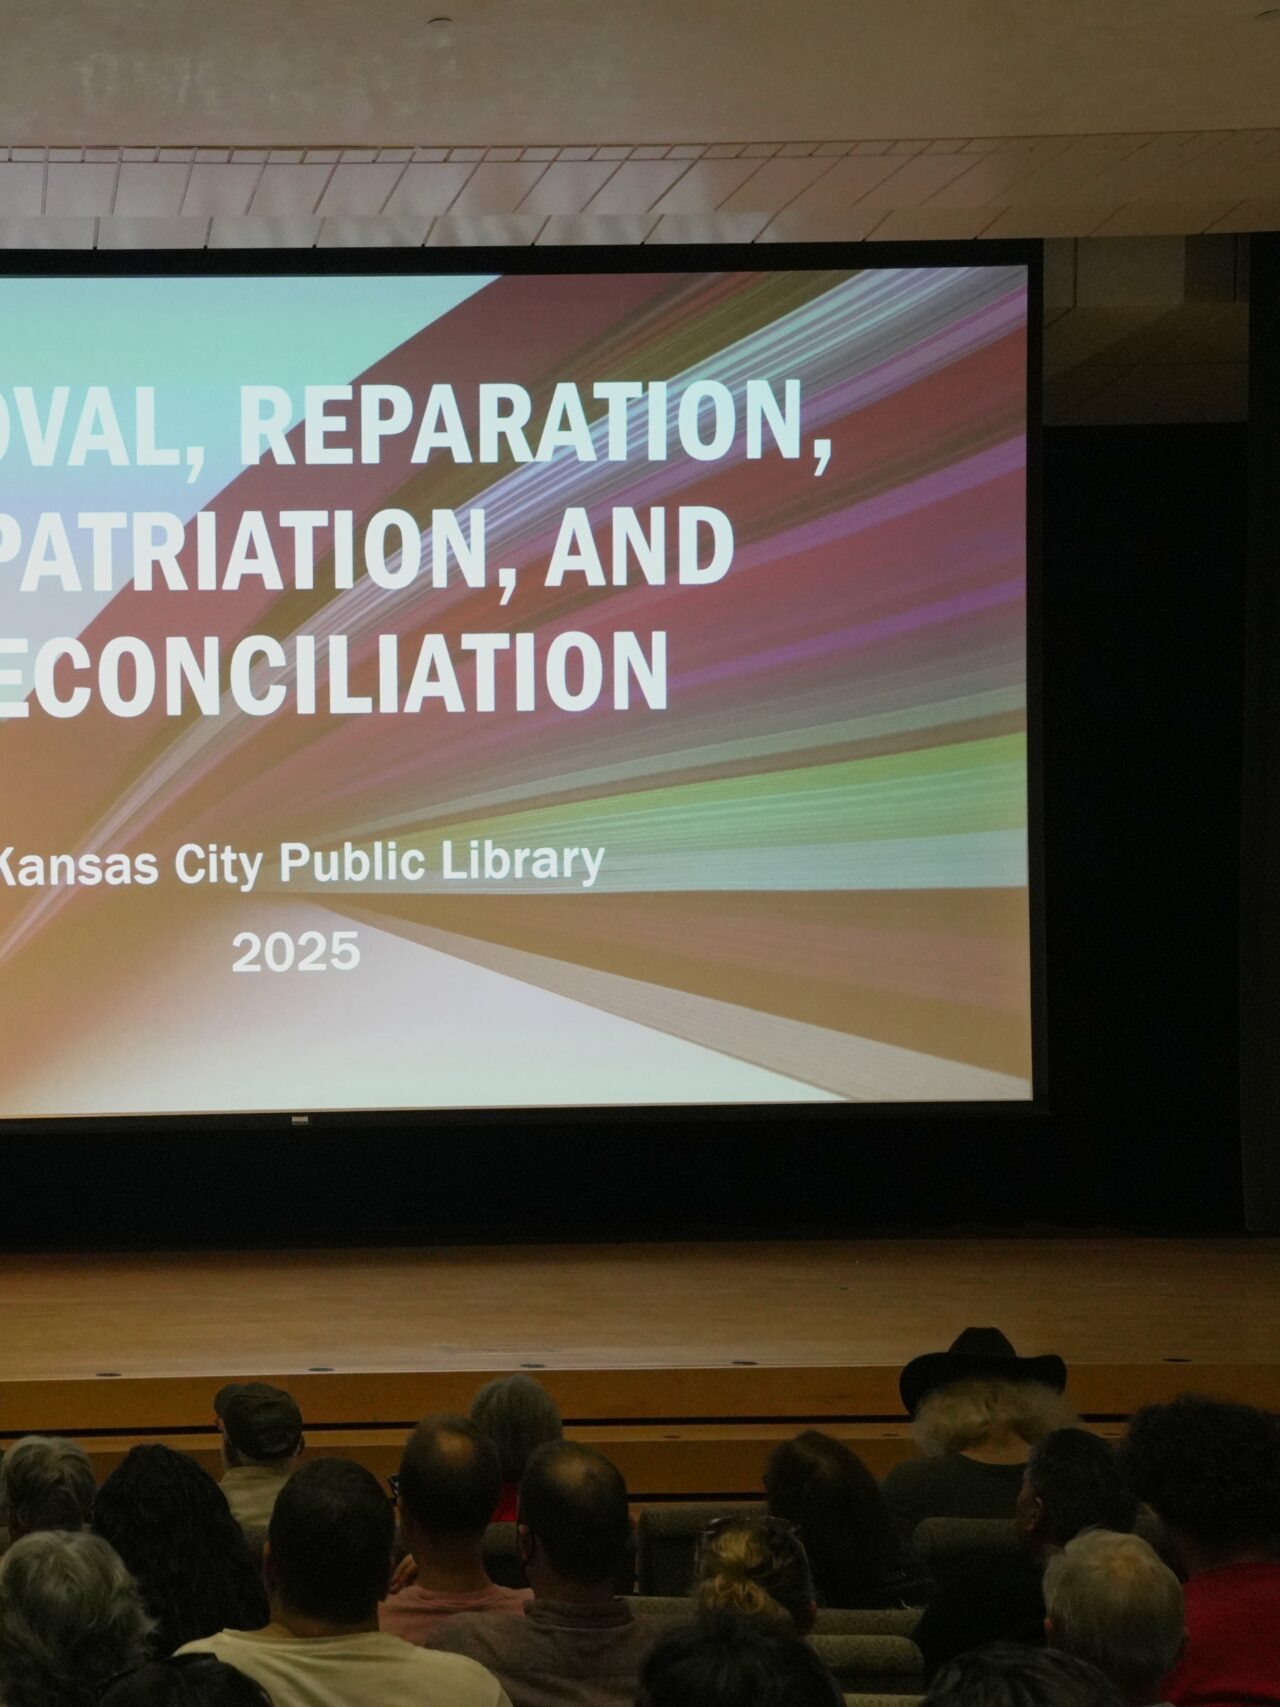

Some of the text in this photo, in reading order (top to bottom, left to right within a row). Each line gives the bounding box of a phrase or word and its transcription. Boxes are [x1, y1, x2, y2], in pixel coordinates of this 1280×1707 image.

[241, 379, 832, 476] REPARATION,
[545, 506, 734, 587] AND
[175, 843, 263, 892] City
[281, 842, 425, 882] Public
[443, 840, 605, 886] Library
[232, 932, 360, 972] 2025
